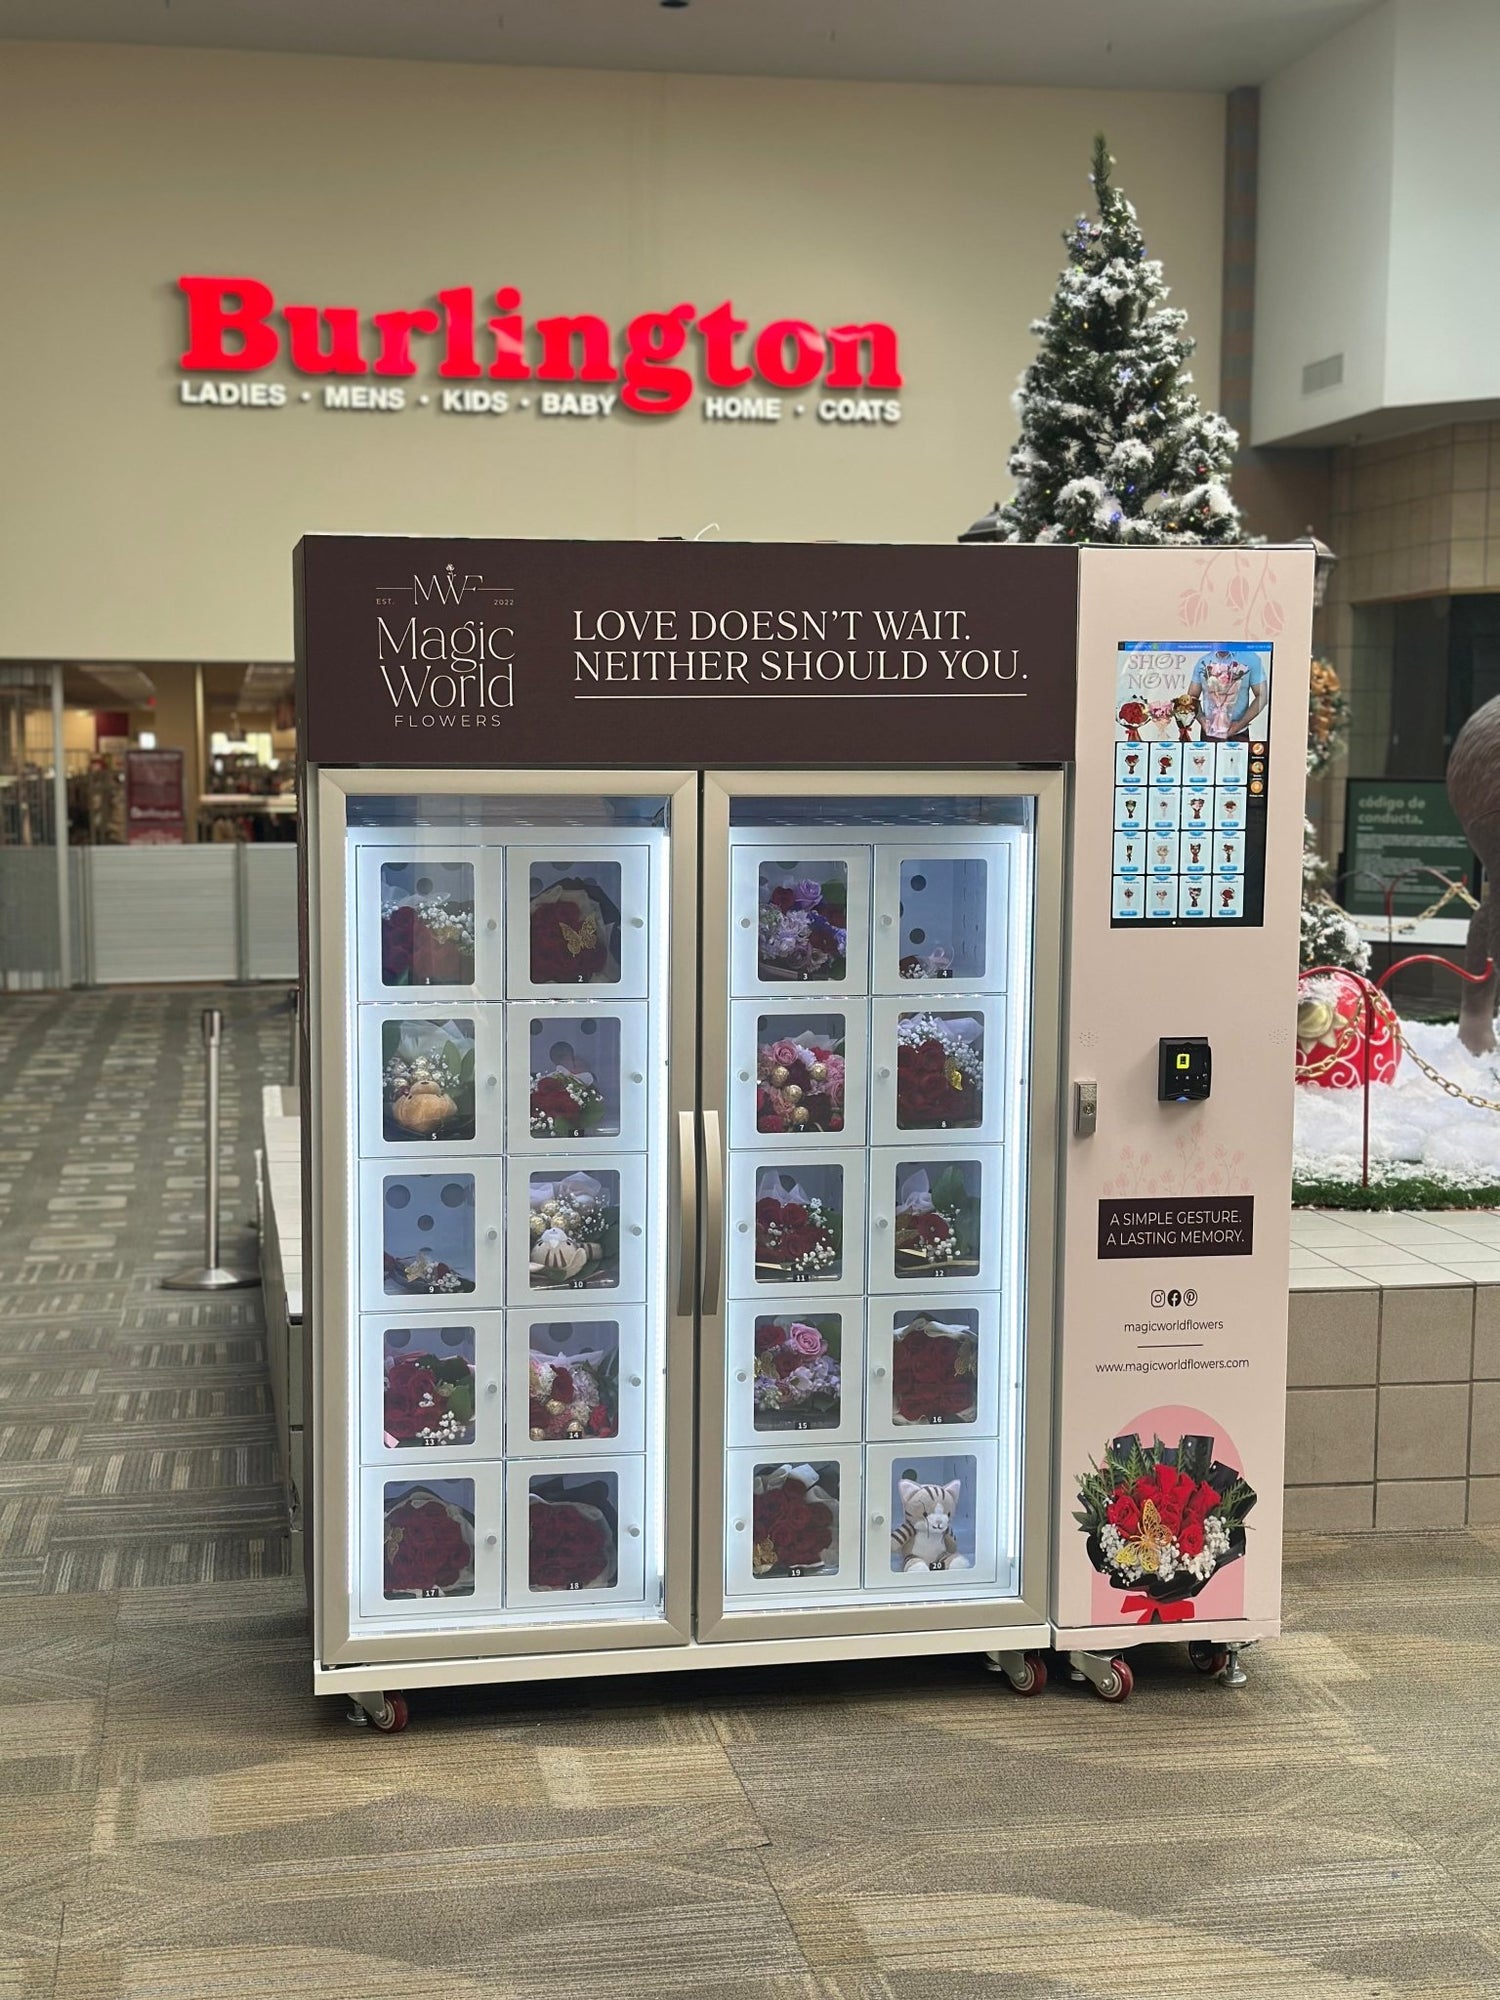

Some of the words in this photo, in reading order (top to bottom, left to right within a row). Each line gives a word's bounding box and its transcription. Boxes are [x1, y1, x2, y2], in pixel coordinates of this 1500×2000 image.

[178, 275, 905, 415] Burlington
[181, 380, 287, 406] LADIES
[324, 385, 405, 410] MENS
[442, 389, 509, 412] KIDS
[542, 392, 617, 415] BABY
[705, 397, 781, 419] HOME
[819, 398, 901, 421] COATS
[573, 610, 678, 641] LOVE
[690, 610, 863, 641] DOESN'T
[872, 609, 971, 641] WAIT.
[377, 617, 516, 673] Magic
[574, 650, 749, 684] NEITHER
[760, 650, 928, 681] SHOULD
[938, 650, 1028, 680] YOU.
[1128, 653, 1186, 670] SHOP
[379, 663, 514, 708] World
[1128, 673, 1186, 689] NOW!
[394, 715, 501, 727] FLOWERS
[1110, 1213, 1120, 1226] A
[1123, 1211, 1173, 1226] SIMPLE
[1177, 1210, 1242, 1224] GESTURE.
[1106, 1232, 1116, 1246] A
[1120, 1231, 1177, 1245] LASTING
[1180, 1229, 1244, 1244] MEMORY.
[1124, 1319, 1224, 1334] magicworldflowers
[1095, 1358, 1250, 1374] www.magicworldflowers.com
